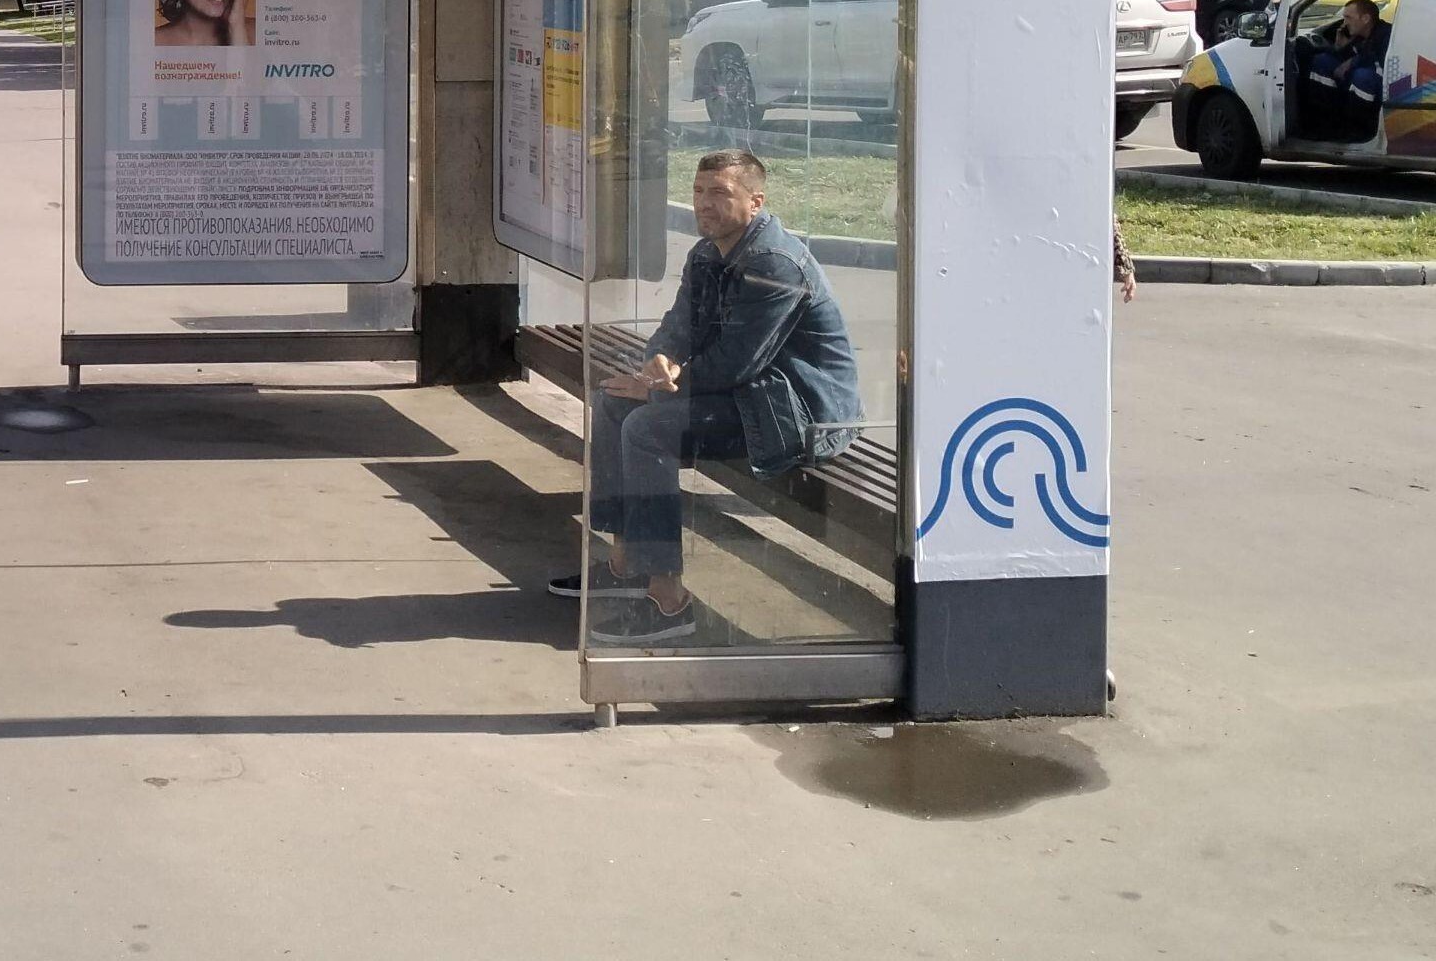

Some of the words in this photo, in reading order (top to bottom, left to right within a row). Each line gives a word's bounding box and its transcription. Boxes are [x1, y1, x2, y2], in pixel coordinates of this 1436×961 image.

[155, 61, 216, 71] Нашедшему
[265, 64, 335, 77] INVITRO
[155, 71, 241, 80] вознаграждение!
[115, 217, 170, 234] ИМЕЮТСЯ
[173, 217, 294, 234] ПРОТИВОПОКАЗАНИЯ.
[297, 216, 374, 234] НЕОБХОДИМО
[115, 240, 182, 257] ПОЛУЧЕНИЕ
[185, 239, 271, 258] КОНСУЛЬТАЦИИ
[275, 238, 356, 258] СПЕЦИАЛИСТА.
